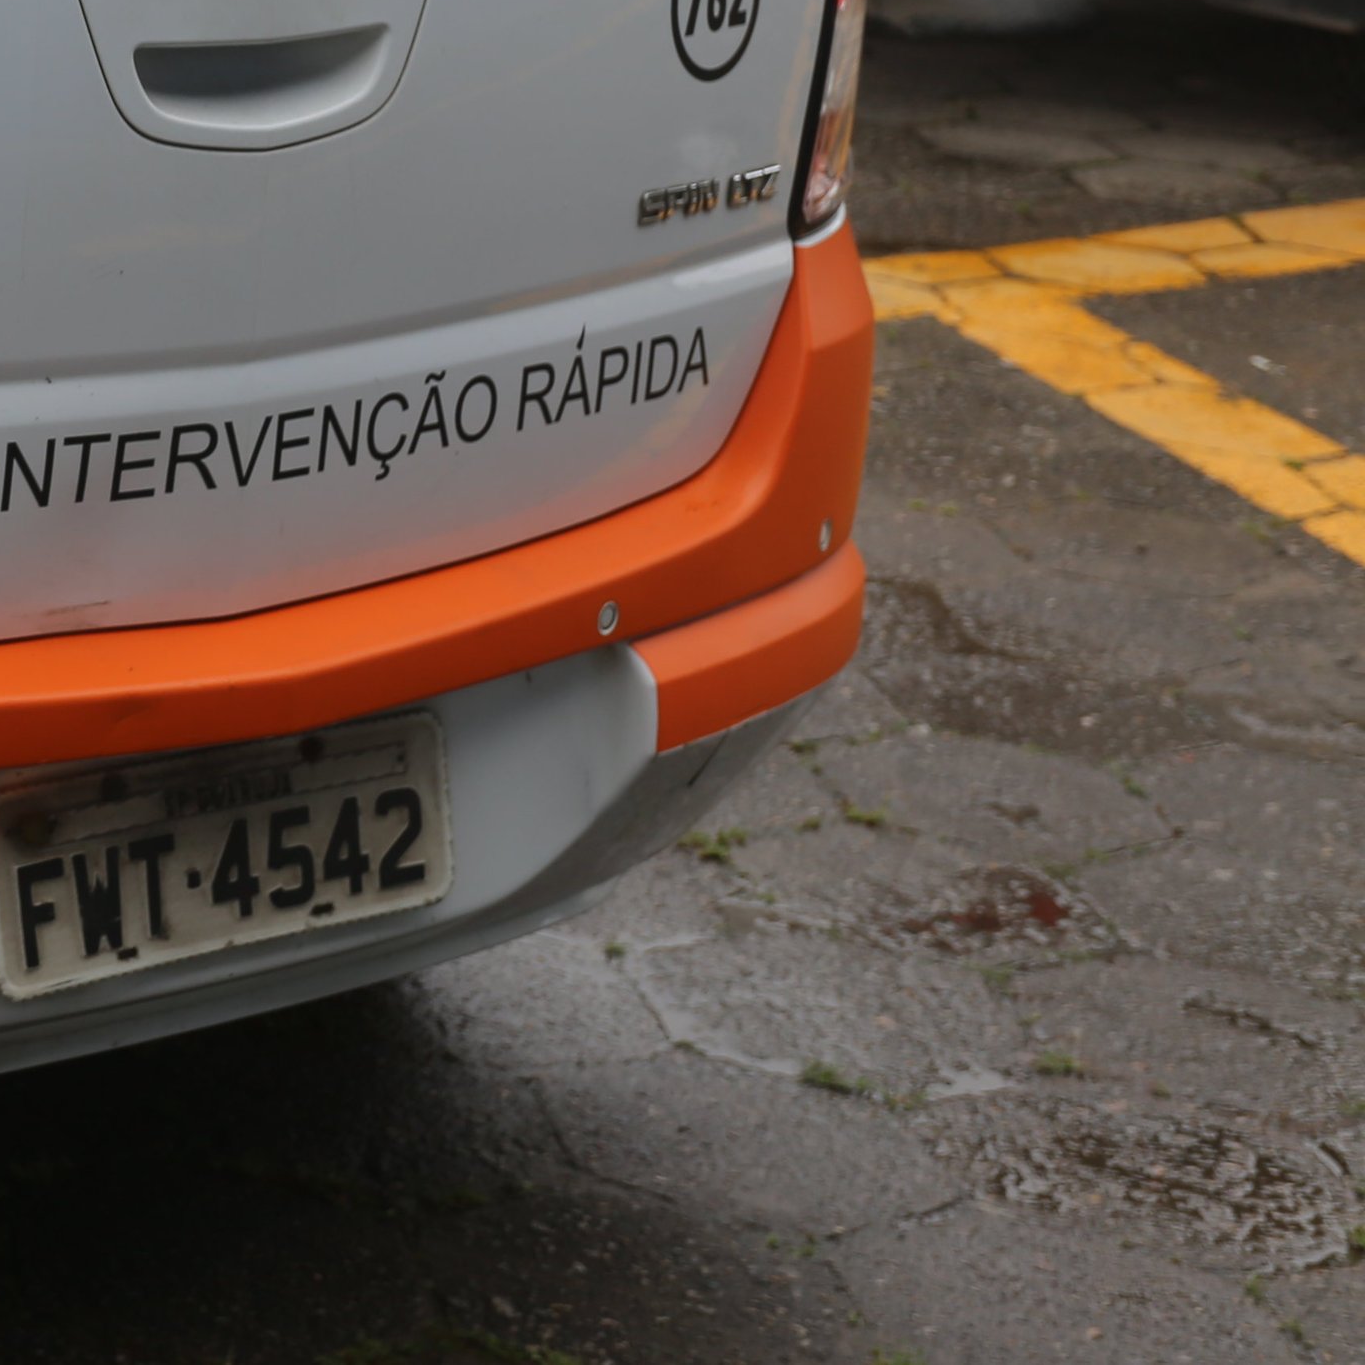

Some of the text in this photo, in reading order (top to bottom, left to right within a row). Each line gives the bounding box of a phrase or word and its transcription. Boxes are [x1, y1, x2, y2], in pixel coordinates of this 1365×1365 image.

[638, 164, 781, 226] SPIN LTZ
[516, 323, 710, 432] RÁPIDA
